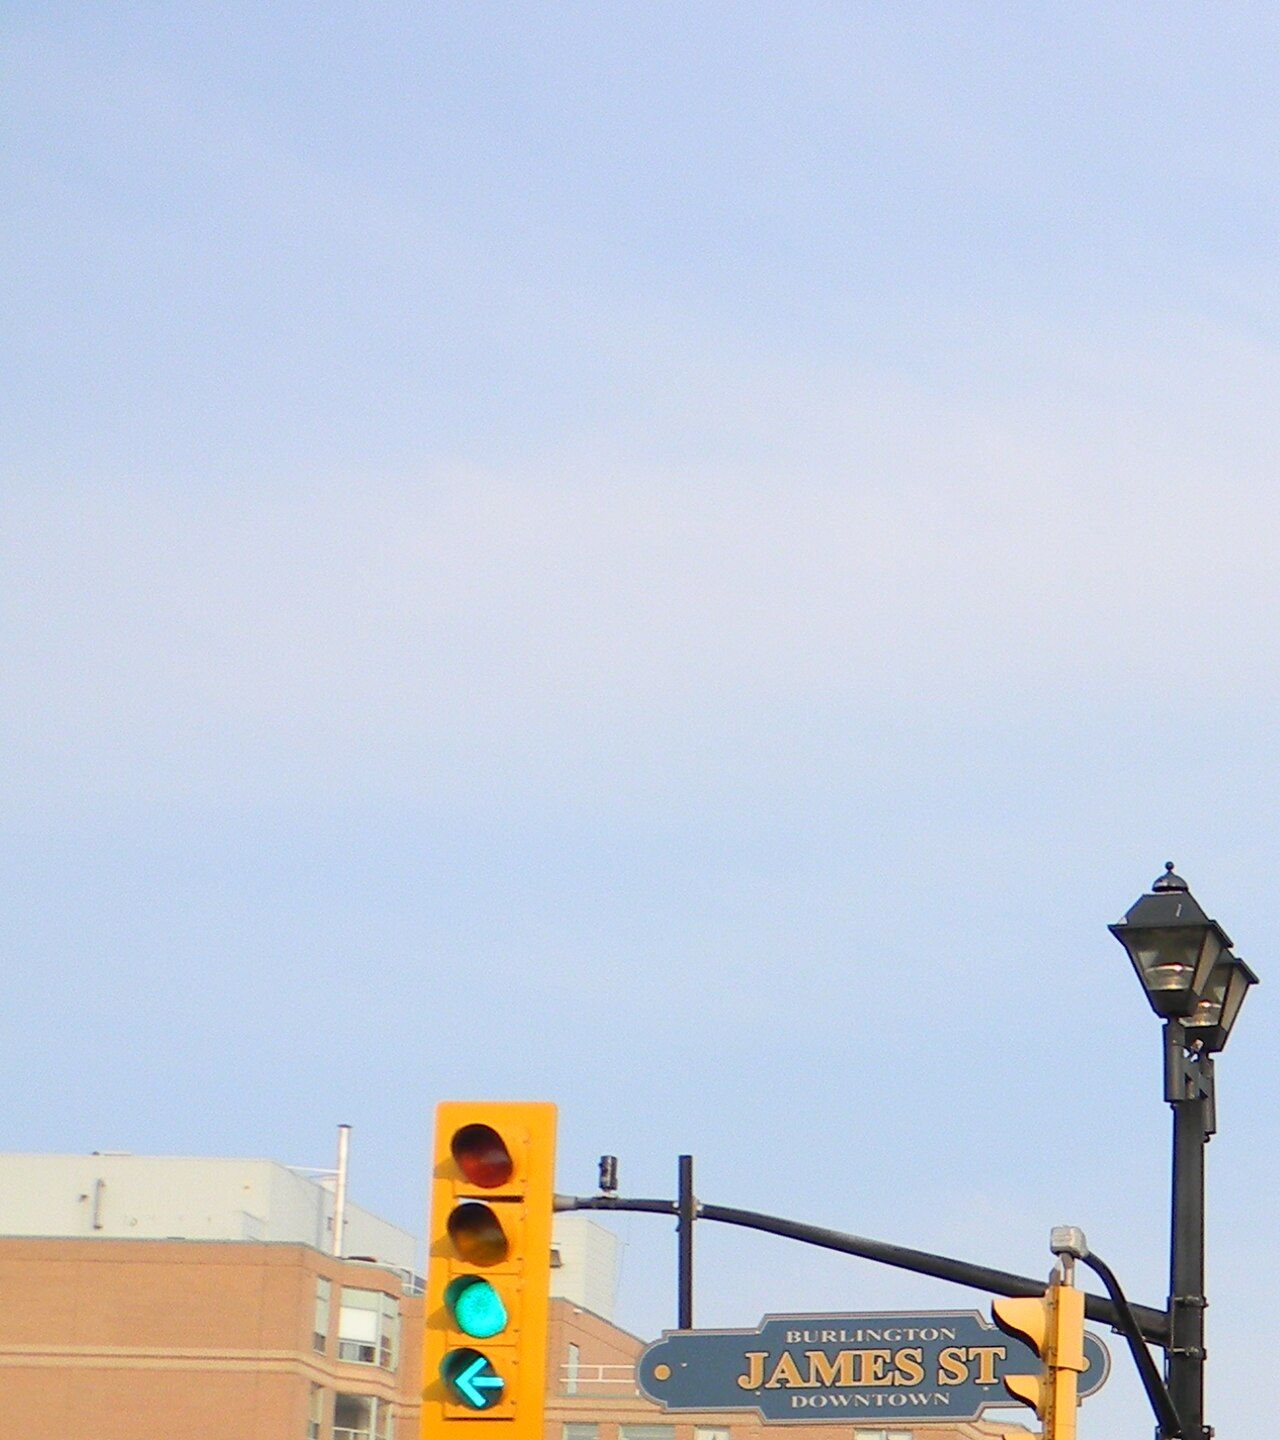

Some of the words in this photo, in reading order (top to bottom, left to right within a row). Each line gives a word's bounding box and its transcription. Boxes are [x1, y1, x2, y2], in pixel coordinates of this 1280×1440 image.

[785, 1327, 958, 1344] BURLINGTON
[737, 1347, 925, 1391] JAMES
[936, 1345, 1008, 1387] ST
[790, 1390, 951, 1409] DOWNTOWN
